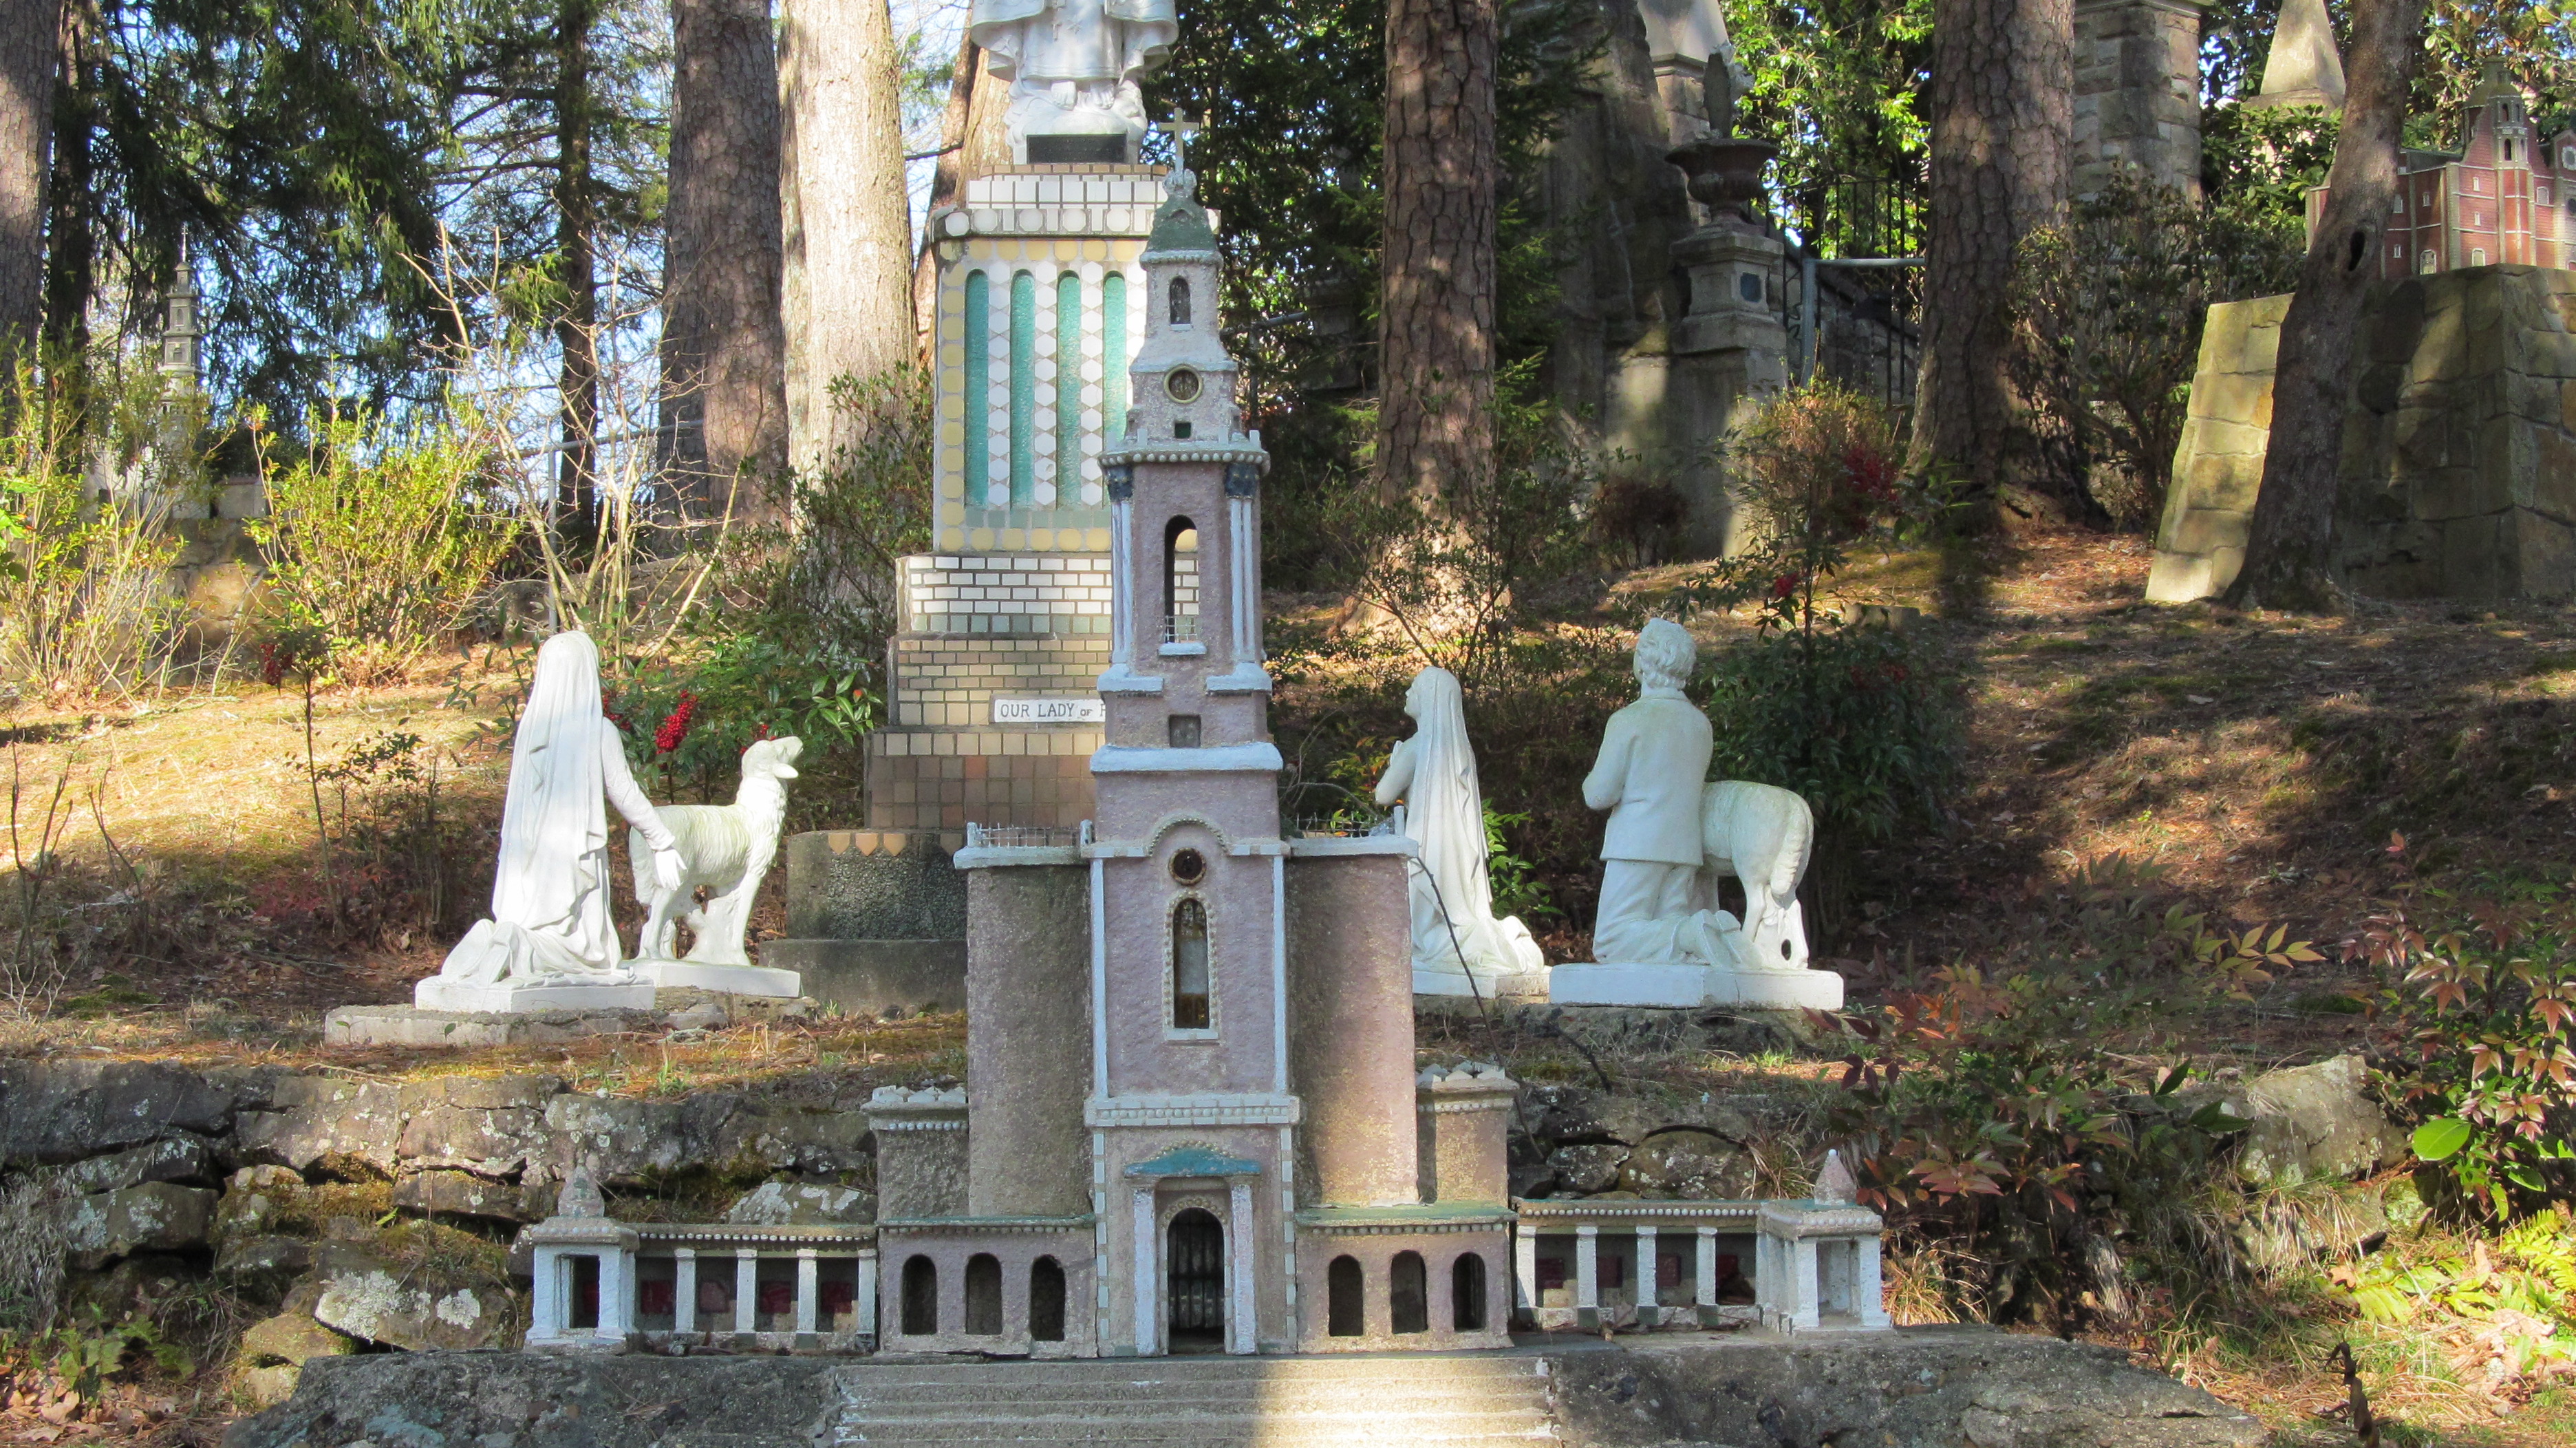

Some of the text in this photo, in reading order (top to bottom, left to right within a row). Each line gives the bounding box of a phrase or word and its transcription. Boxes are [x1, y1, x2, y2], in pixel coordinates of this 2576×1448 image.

[1000, 703, 1030, 717] OUR
[1038, 703, 1075, 717] LADY
[1080, 708, 1093, 716] OF
